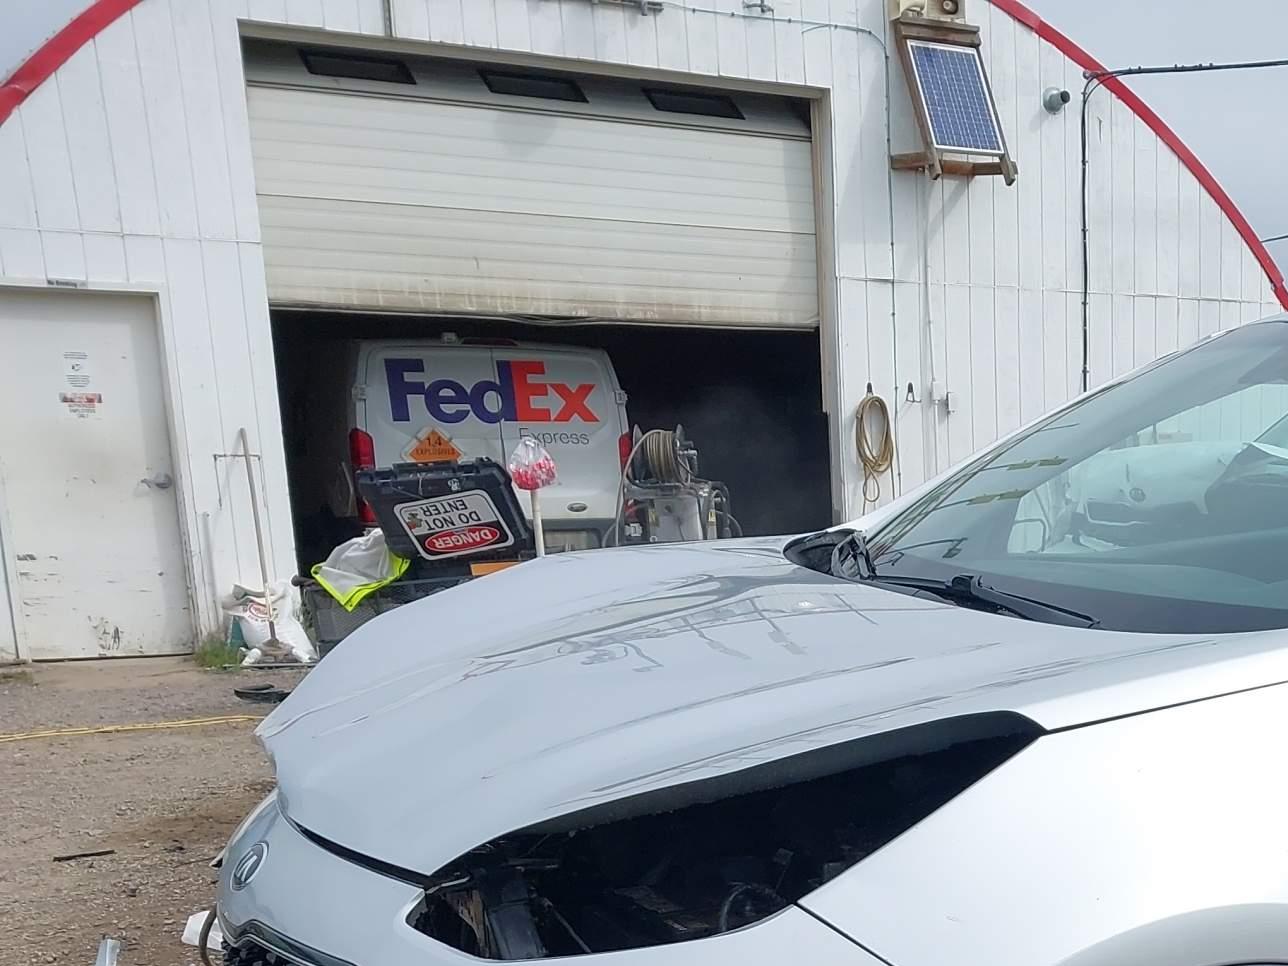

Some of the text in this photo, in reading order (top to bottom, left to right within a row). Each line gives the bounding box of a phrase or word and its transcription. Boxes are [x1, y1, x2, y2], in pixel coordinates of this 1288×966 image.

[384, 358, 600, 424] FedEx
[519, 427, 590, 447] Express
[420, 499, 468, 517] ENTER
[424, 511, 481, 531] DO NOT
[432, 529, 493, 549] DANGER
